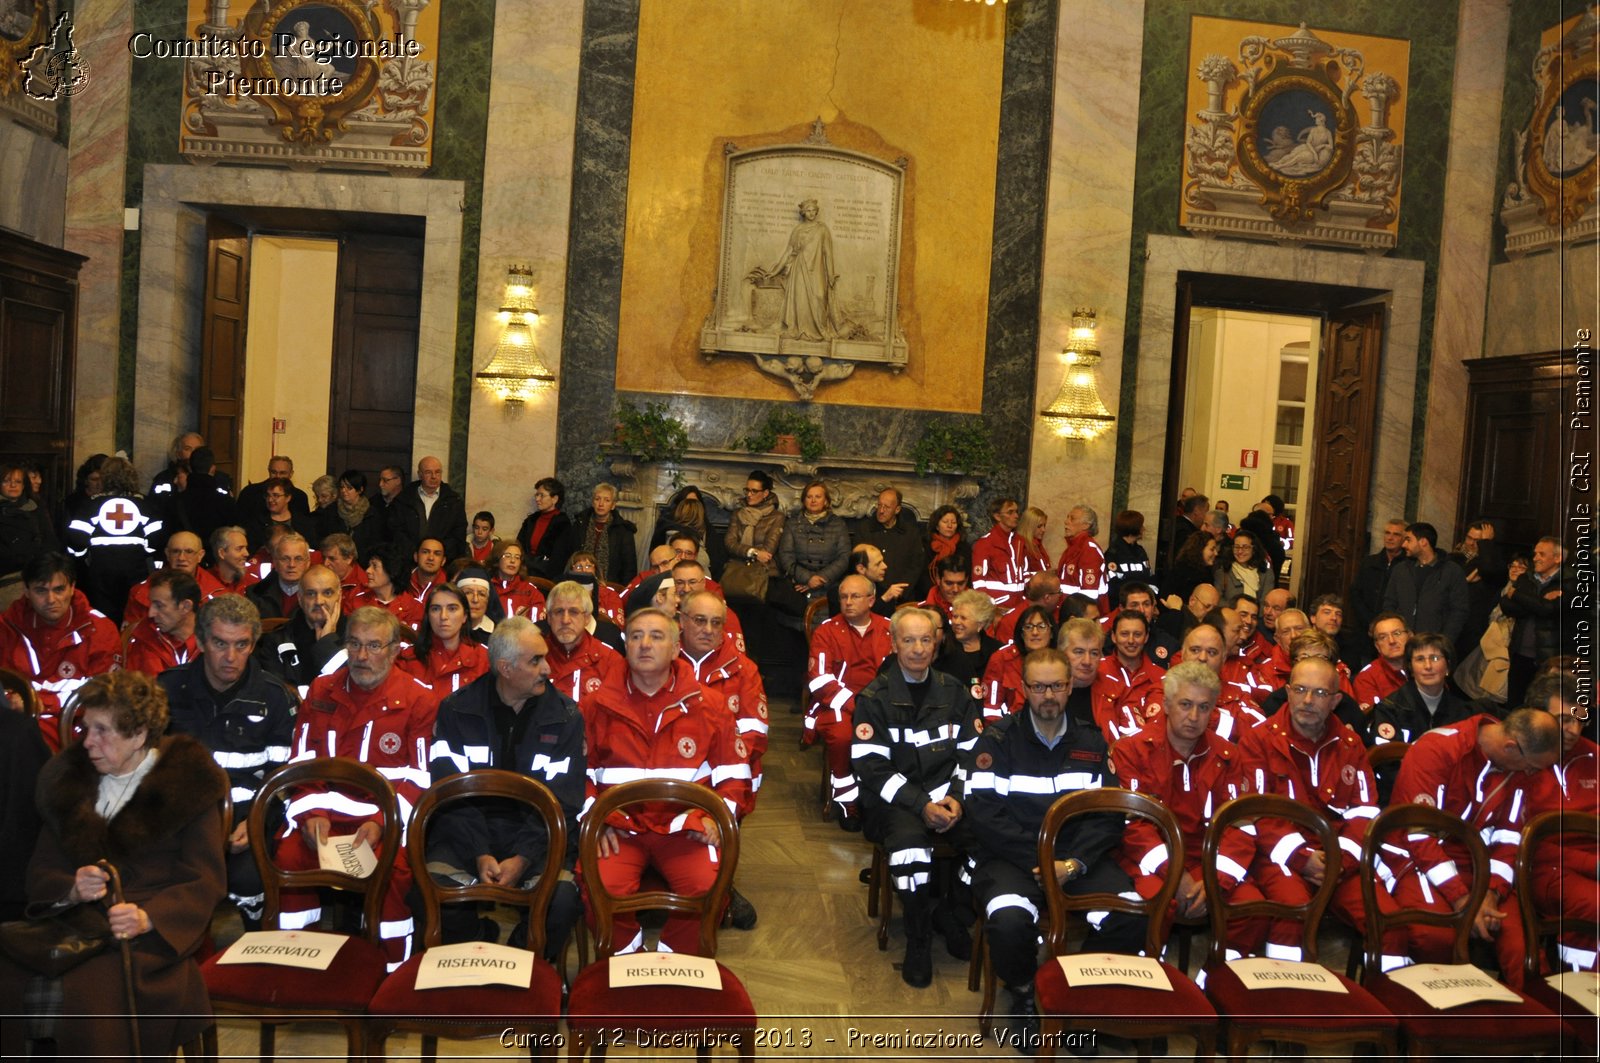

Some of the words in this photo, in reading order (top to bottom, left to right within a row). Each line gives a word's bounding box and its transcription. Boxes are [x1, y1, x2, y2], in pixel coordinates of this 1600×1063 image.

[241, 945, 322, 959] RISERVATO
[437, 958, 517, 970] RISERVATO
[626, 967, 705, 979] RISERVATO
[1079, 967, 1154, 980] RISERVATO
[1252, 971, 1327, 983] RISERVATO
[1422, 978, 1493, 990] RISERVATO
